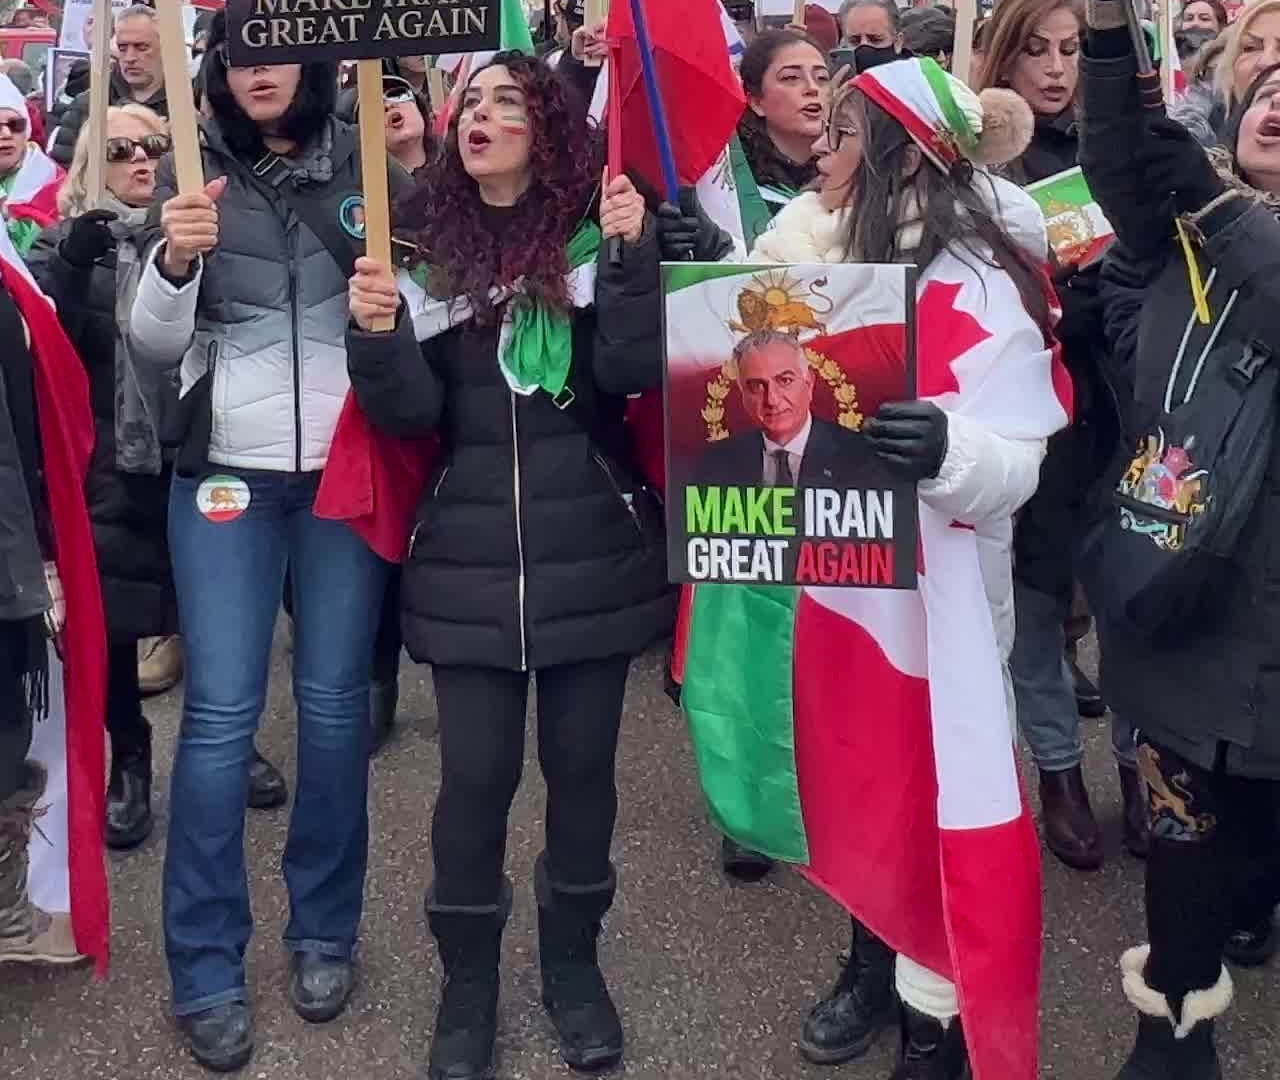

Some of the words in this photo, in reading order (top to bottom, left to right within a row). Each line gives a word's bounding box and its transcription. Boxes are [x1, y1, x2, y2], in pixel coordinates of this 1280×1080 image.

[240, 14, 365, 48] GREAT
[371, 6, 489, 41] AGAIN
[685, 485, 797, 537] MAKE
[803, 487, 894, 539] IRAN
[686, 536, 789, 582] GREAT
[795, 541, 896, 586] AGAIN
